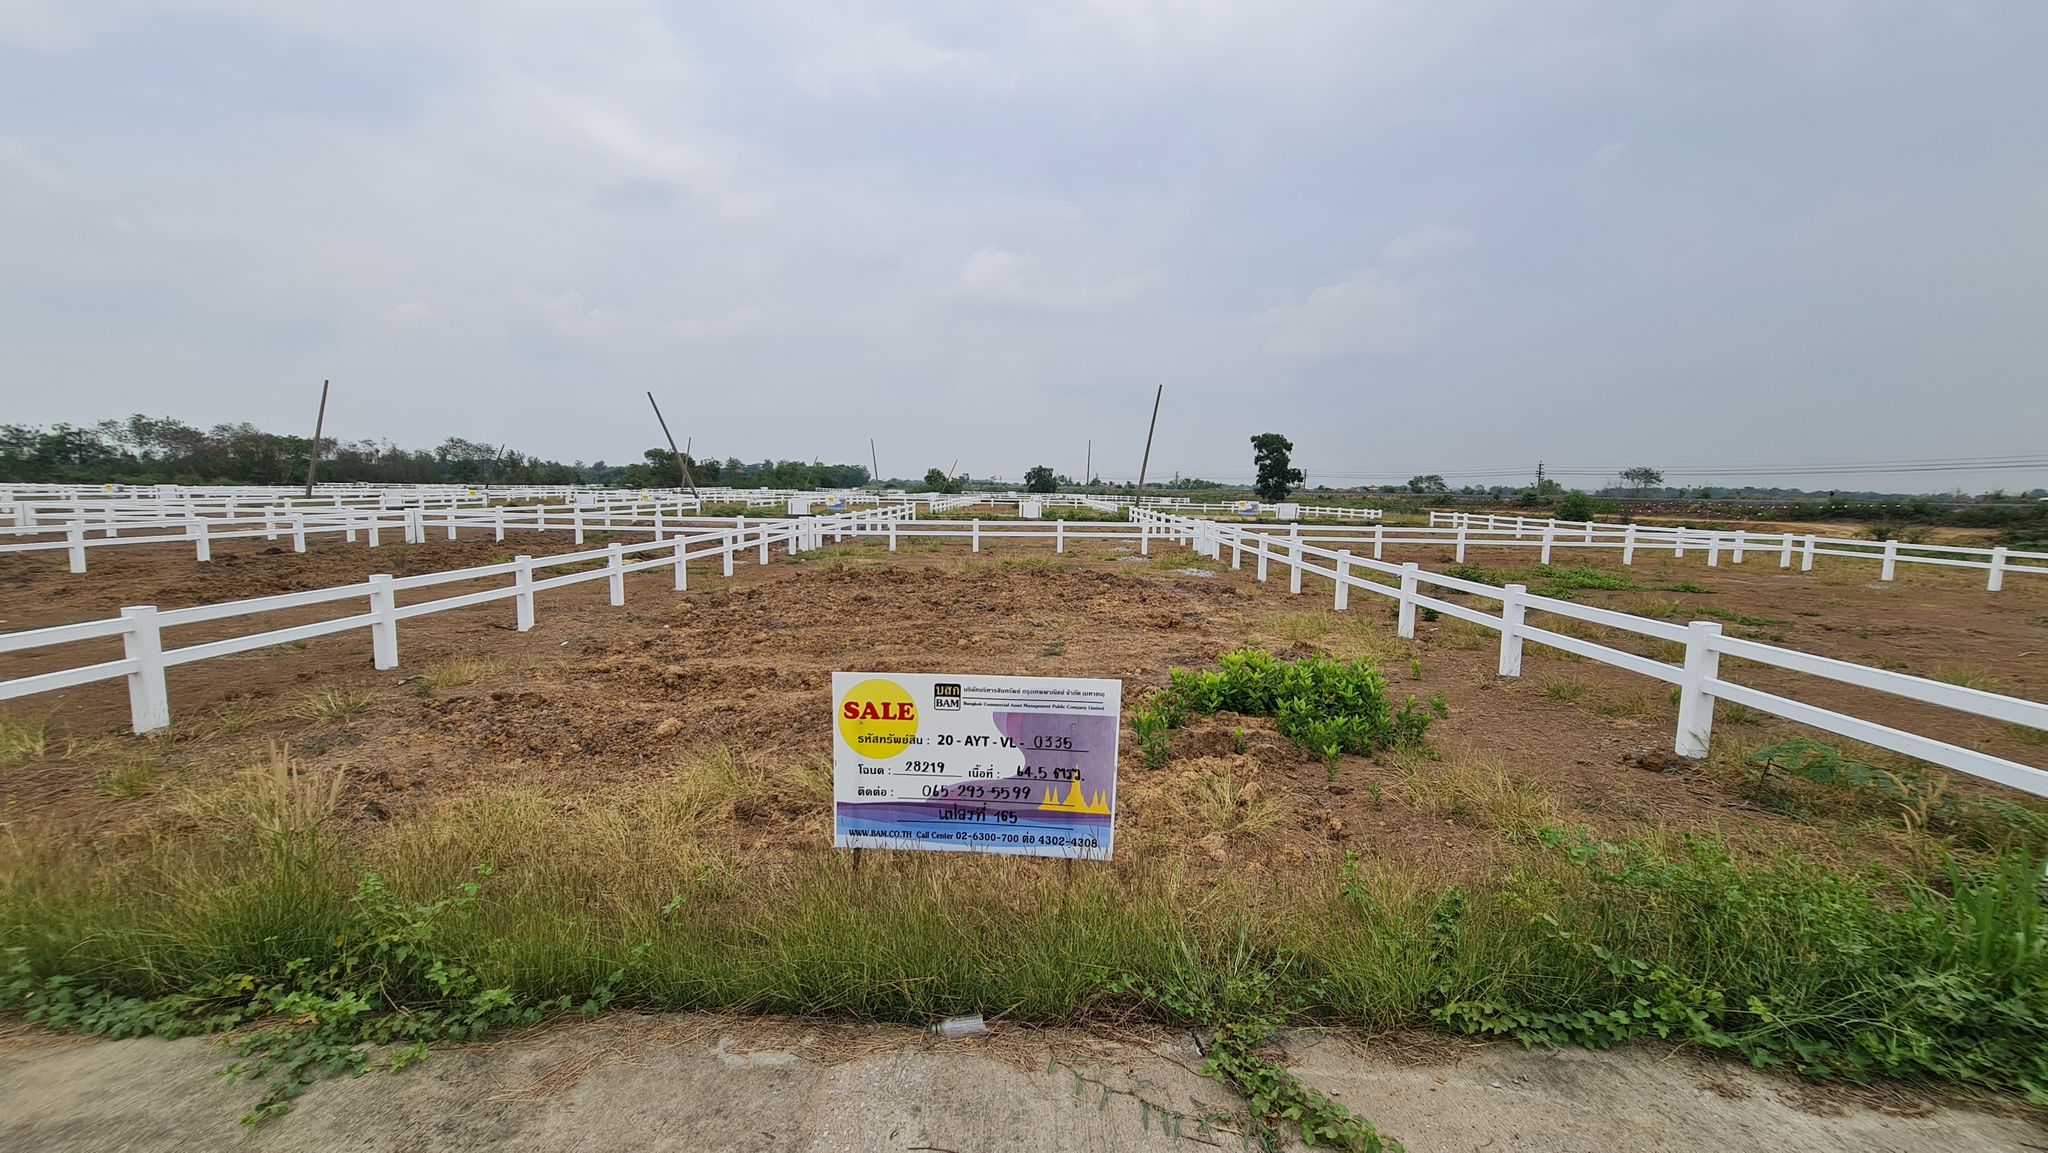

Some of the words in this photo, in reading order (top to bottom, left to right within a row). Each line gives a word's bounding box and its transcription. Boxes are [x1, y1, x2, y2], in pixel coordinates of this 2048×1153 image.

[936, 685, 960, 696] บสก
[844, 701, 914, 720] SALE
[936, 699, 959, 708] BAM
[857, 733, 923, 745] รหัสทรัพย์สิน
[937, 734, 954, 746] 20
[964, 735, 990, 747] AYT
[1000, 736, 1017, 748] VL
[1033, 735, 1073, 749] 0335
[905, 760, 945, 773] 28219
[968, 763, 994, 779] เนื้อที่
[1016, 765, 1048, 779] 64.5
[857, 785, 888, 797] ติดต่อ
[993, 810, 1018, 824] 165
[848, 828, 912, 839] WWW.BAM.CO.TH
[916, 831, 930, 840] Call
[931, 831, 954, 840] Center
[955, 831, 1020, 843] 02-6300-700
[1022, 830, 1036, 844] ต่อ
[1038, 835, 1099, 849] 4302-4308
